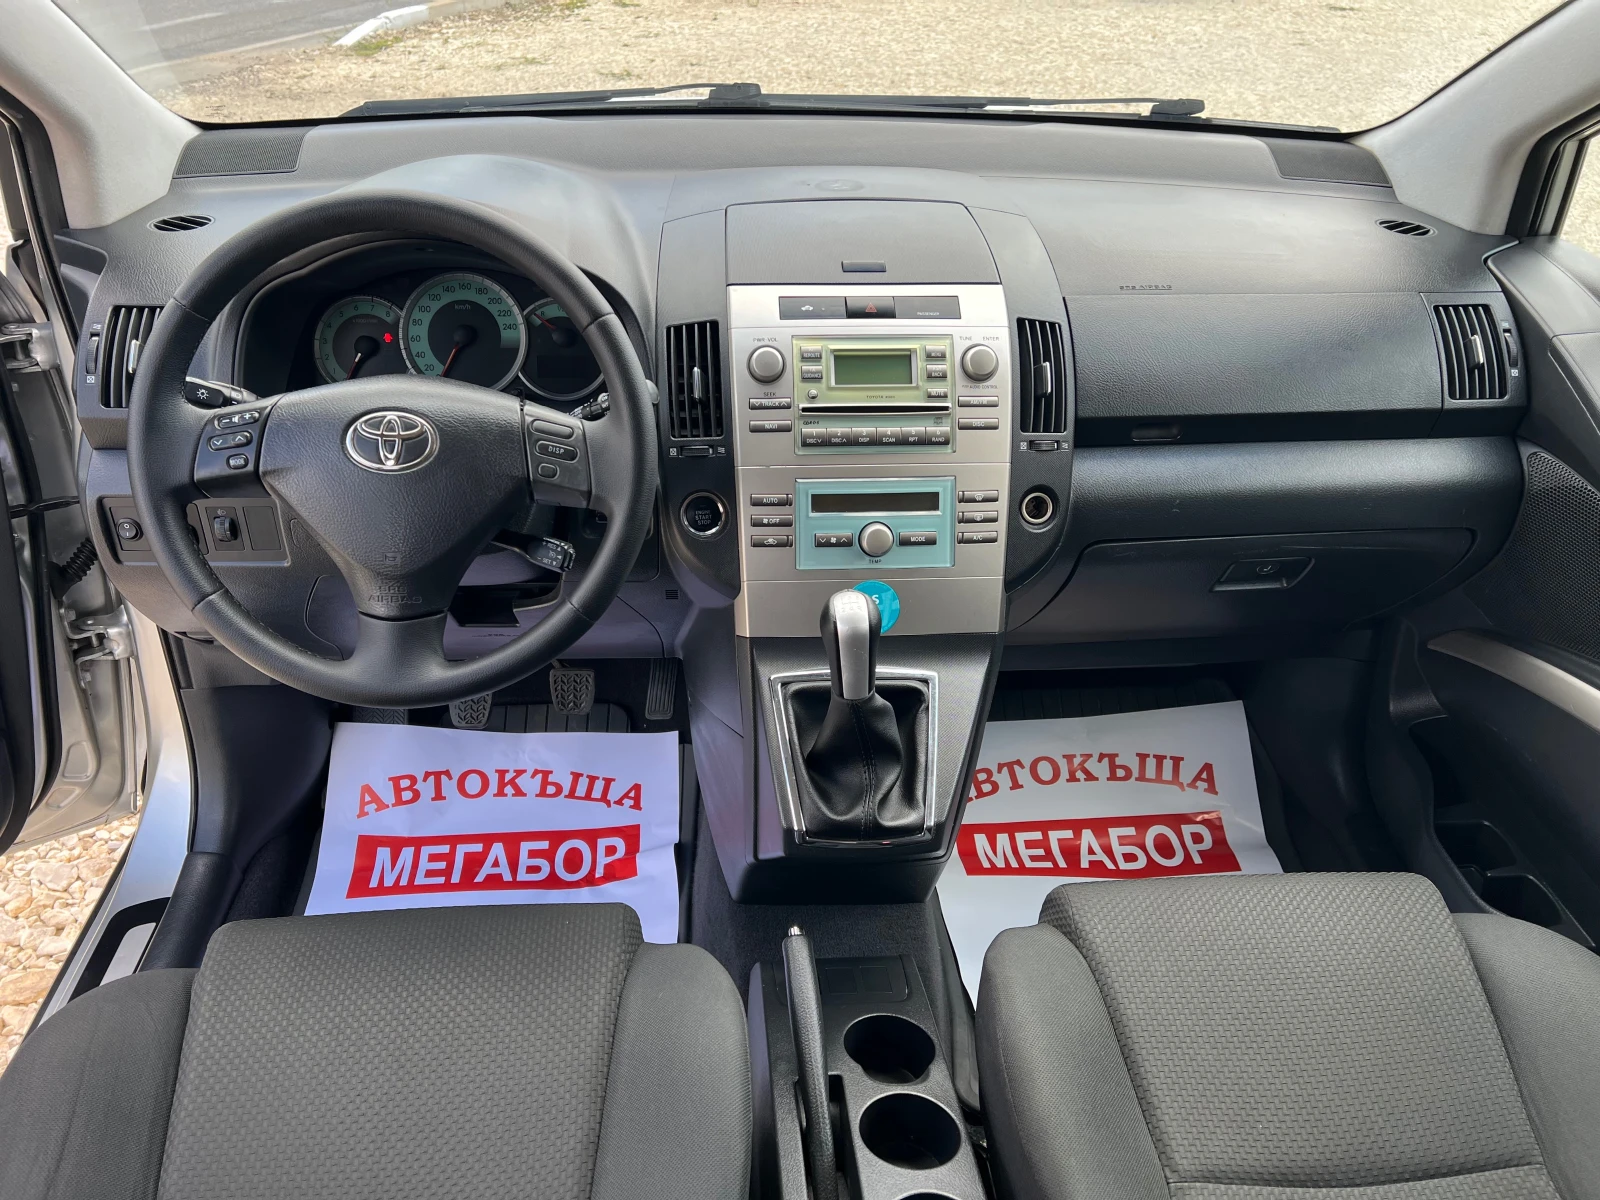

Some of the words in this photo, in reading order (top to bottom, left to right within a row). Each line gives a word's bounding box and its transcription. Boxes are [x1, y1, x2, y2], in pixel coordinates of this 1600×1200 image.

[442, 285, 456, 293] 140
[458, 282, 472, 291] 160
[475, 287, 489, 295] 180
[428, 293, 442, 302] 120
[487, 297, 503, 305] 200
[418, 305, 432, 313] 100
[497, 309, 512, 317] 220
[412, 318, 423, 326] 80
[502, 323, 518, 331] 240
[410, 334, 421, 342] 60
[415, 351, 426, 359] 40
[424, 364, 435, 372] 20
[548, 445, 565, 455] DISP
[356, 768, 643, 819] АВТОКЪЩА
[973, 824, 1213, 871] МЕГАБОР
[369, 836, 626, 889] МЕГАБОР
